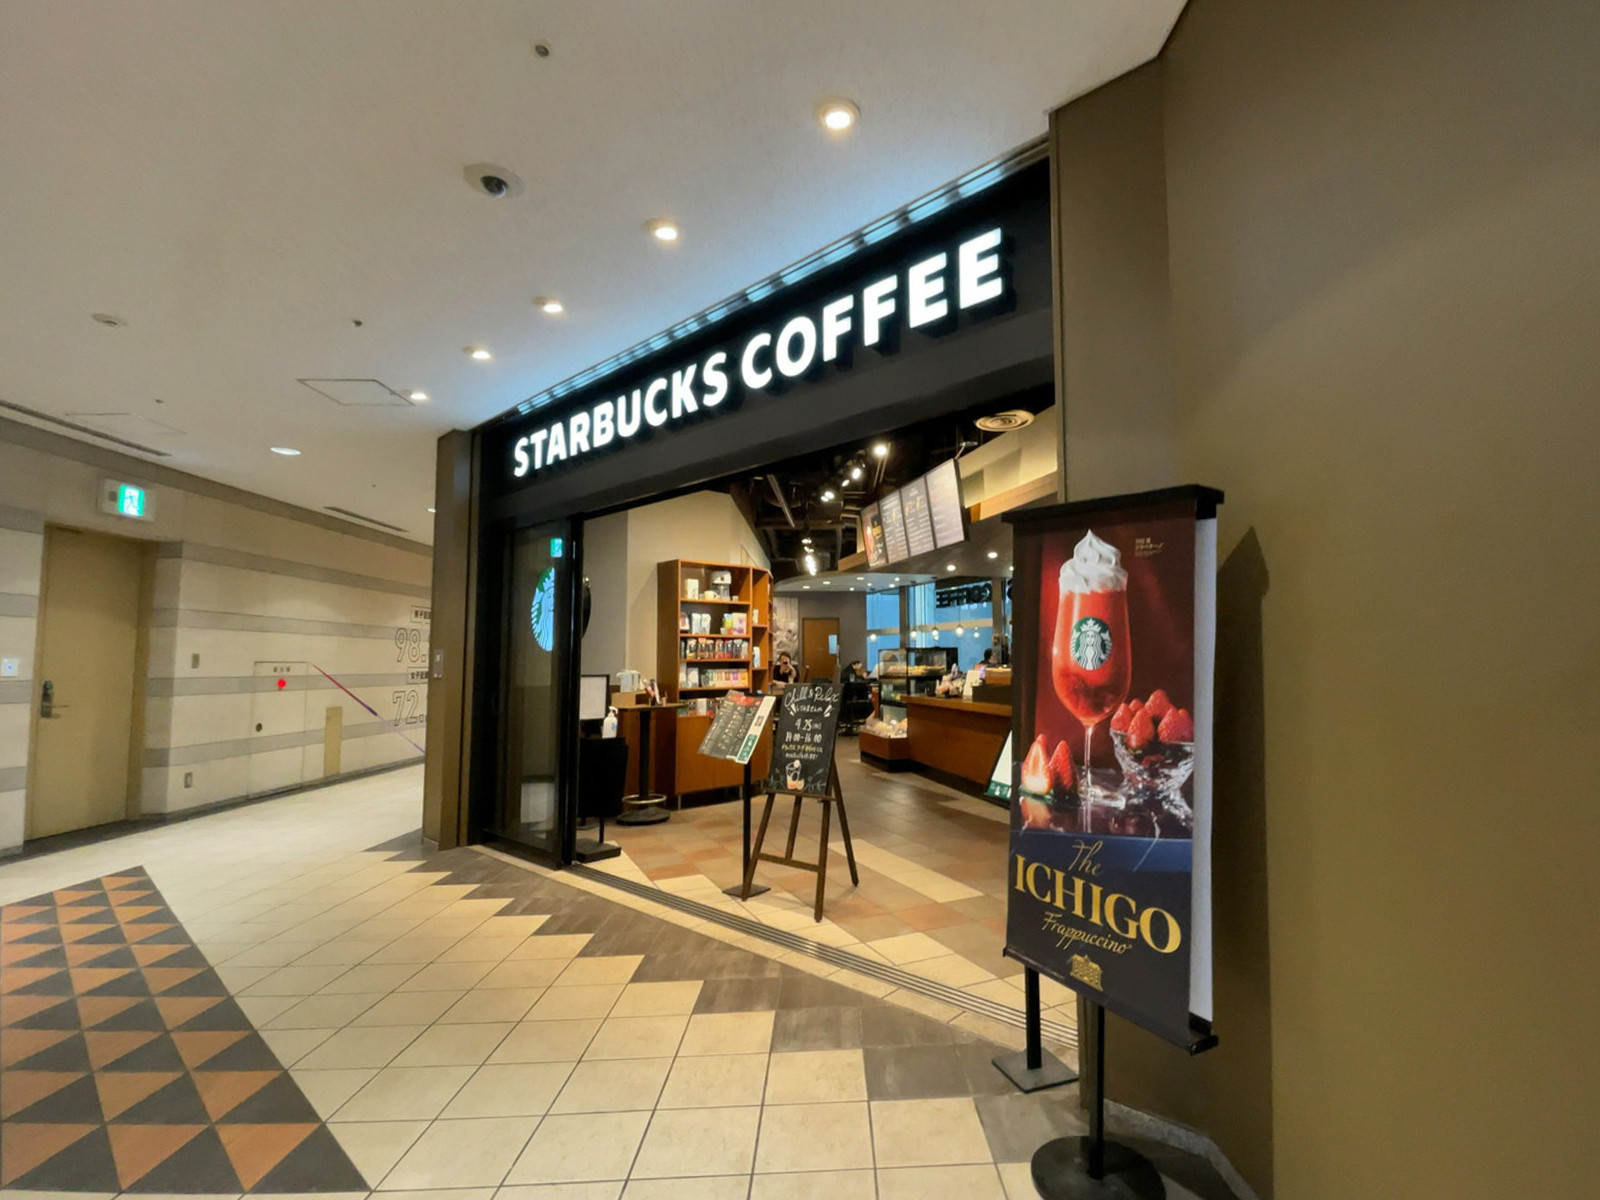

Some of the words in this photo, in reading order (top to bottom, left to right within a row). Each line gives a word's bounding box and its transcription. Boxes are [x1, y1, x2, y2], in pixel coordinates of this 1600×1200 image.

[513, 351, 728, 478] STARBUCKS
[741, 227, 1003, 389] COFFEE
[1014, 854, 1182, 954] ICHIGO
[1068, 839, 1104, 876] The
